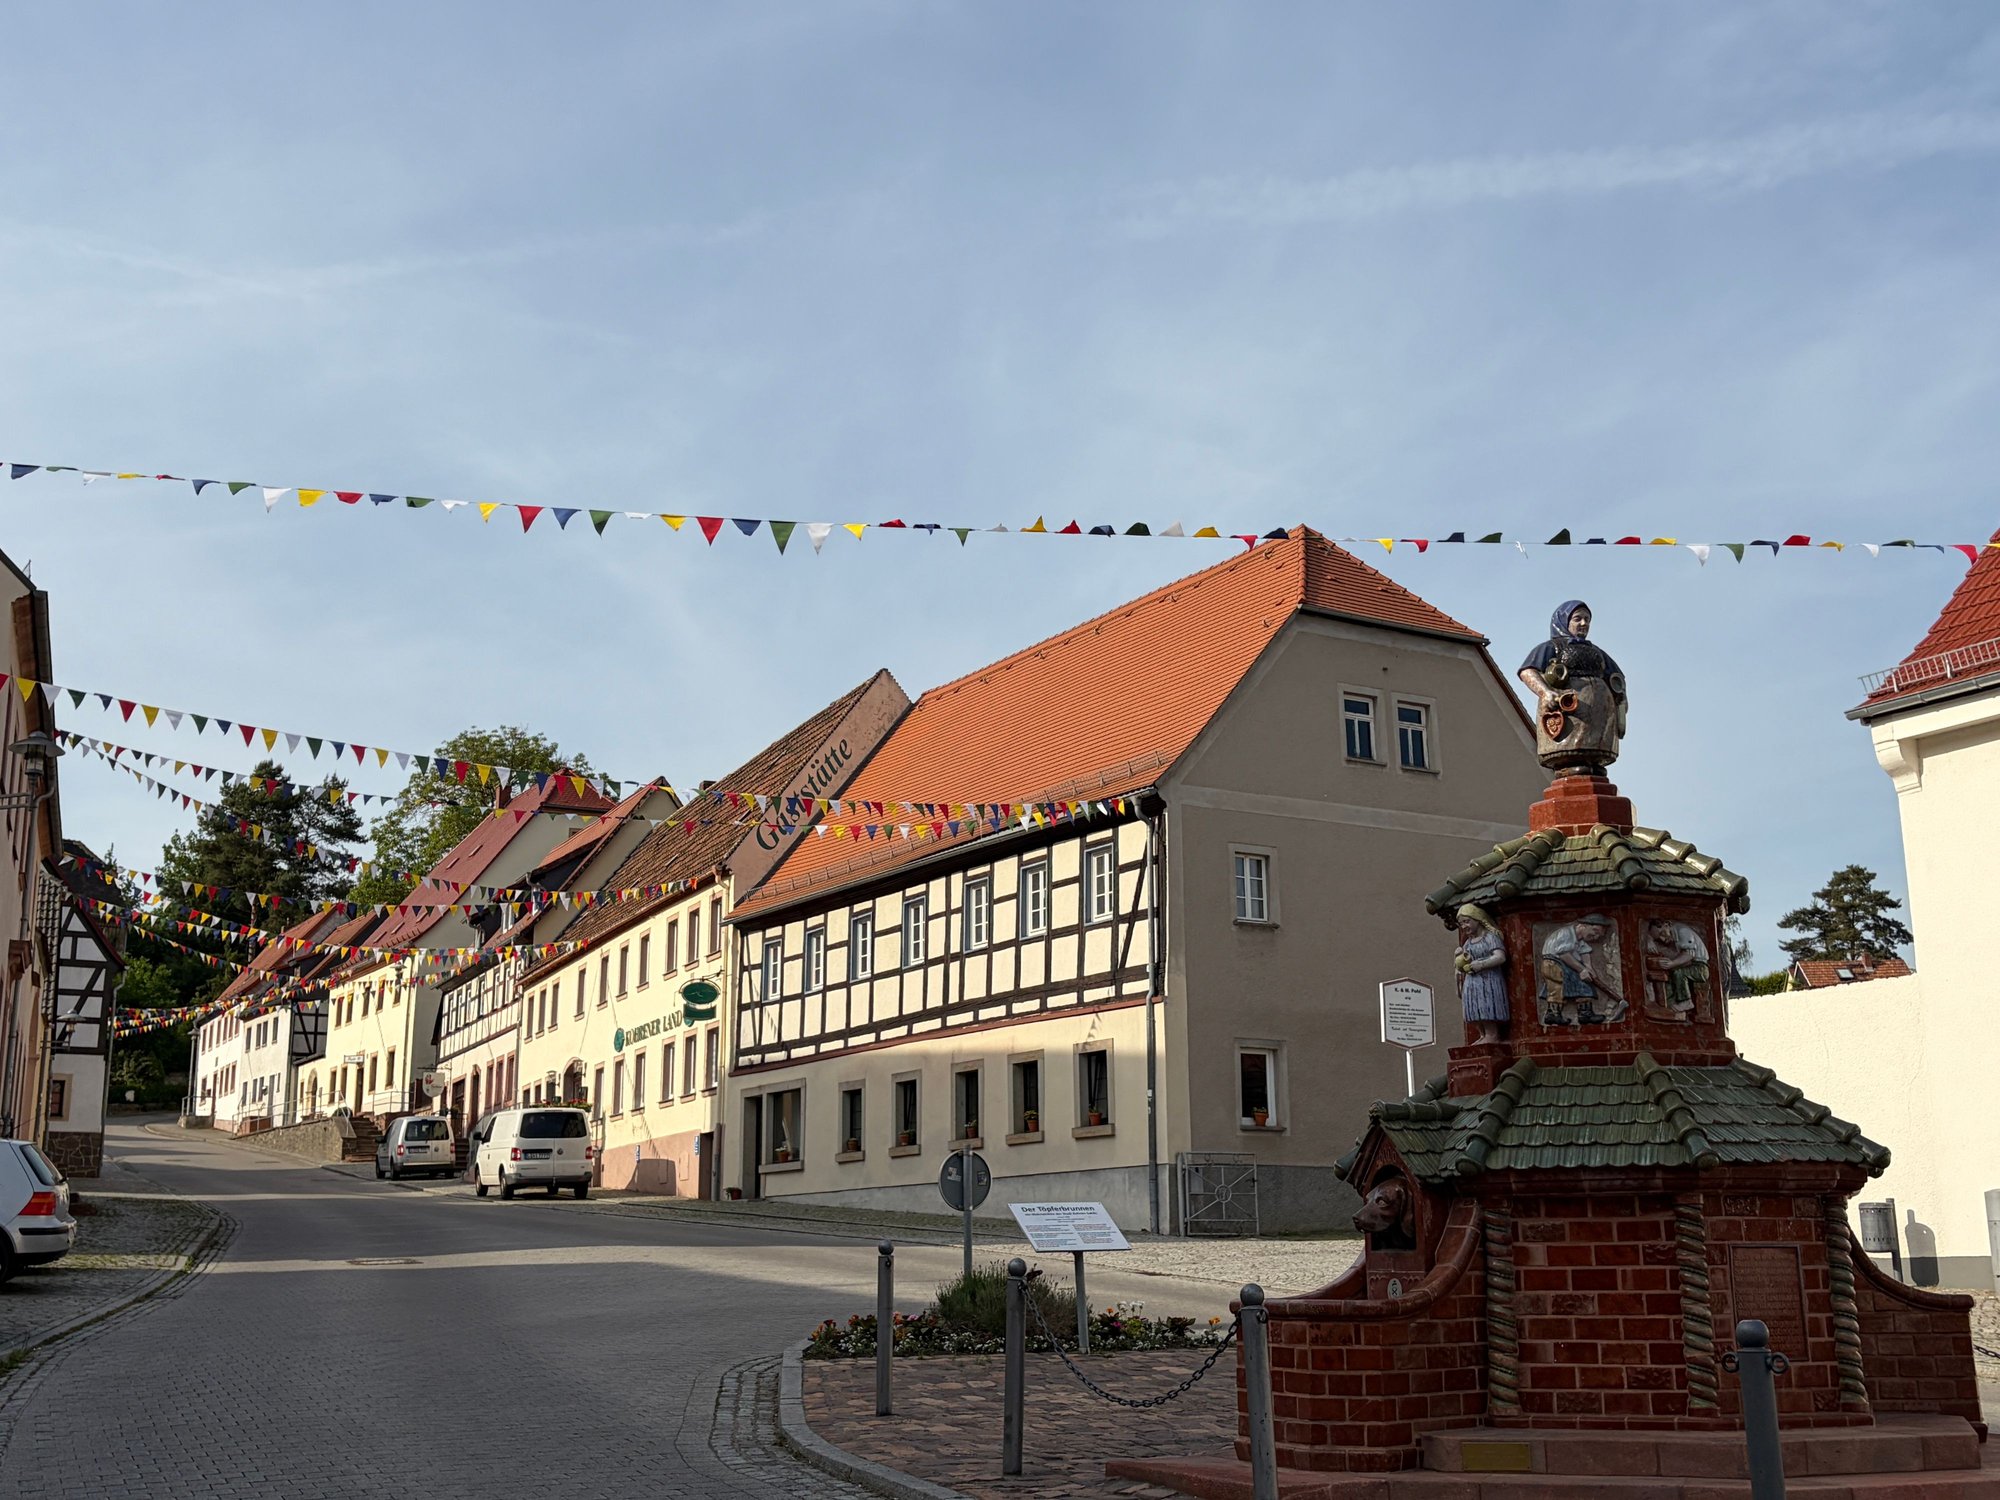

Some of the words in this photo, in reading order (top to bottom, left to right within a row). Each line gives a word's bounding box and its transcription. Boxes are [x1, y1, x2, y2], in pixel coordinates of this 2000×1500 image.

[756, 739, 853, 850] Gaststätte
[662, 1010, 683, 1033] LAND
[1038, 1205, 1095, 1213] Töpferbrunnen
